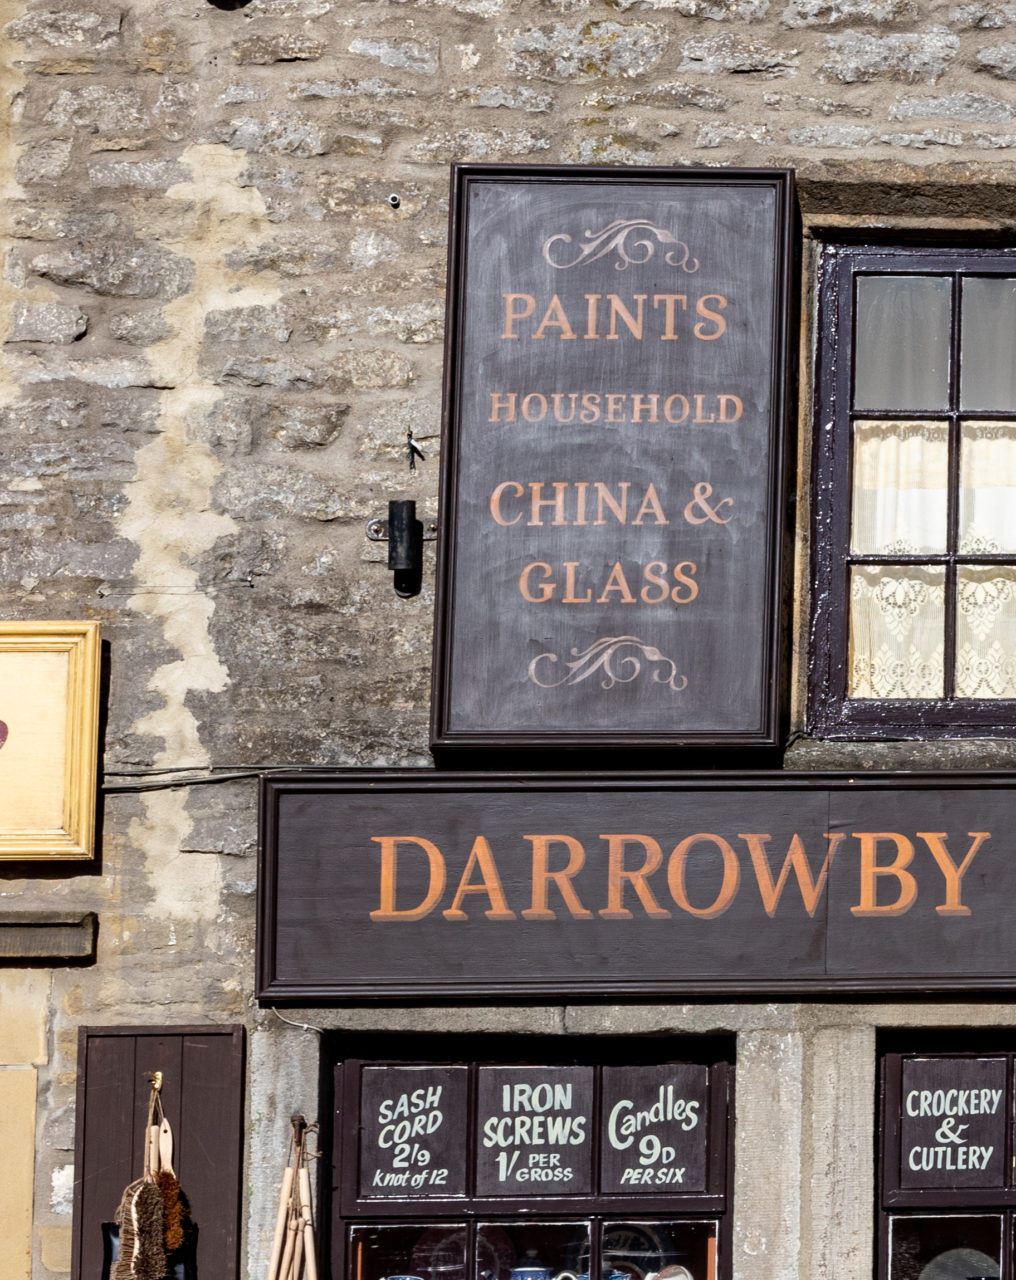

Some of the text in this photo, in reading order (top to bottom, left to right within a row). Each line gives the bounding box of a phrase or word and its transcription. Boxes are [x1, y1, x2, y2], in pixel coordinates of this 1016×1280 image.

[501, 293, 728, 340] PAINTS
[488, 393, 743, 423] HOUSEHOLD
[490, 481, 734, 526] CHINA &
[519, 561, 699, 604] GLASS
[370, 832, 991, 922] DARROWBY
[378, 1085, 443, 1125] SASH
[502, 1083, 573, 1113] IRON
[906, 1088, 1003, 1117] CROCKERY
[378, 1110, 443, 1148] CORD
[483, 1116, 586, 1148] SCREWS
[608, 1085, 700, 1151] Candles
[935, 1117, 970, 1144] &
[392, 1144, 431, 1168] 2/9
[528, 1153, 560, 1168] PER
[909, 1145, 994, 1171] CUTLERY
[373, 1169, 448, 1189] knot of 12
[516, 1168, 574, 1181] GROSS
[620, 1167, 686, 1184] PER SIX
